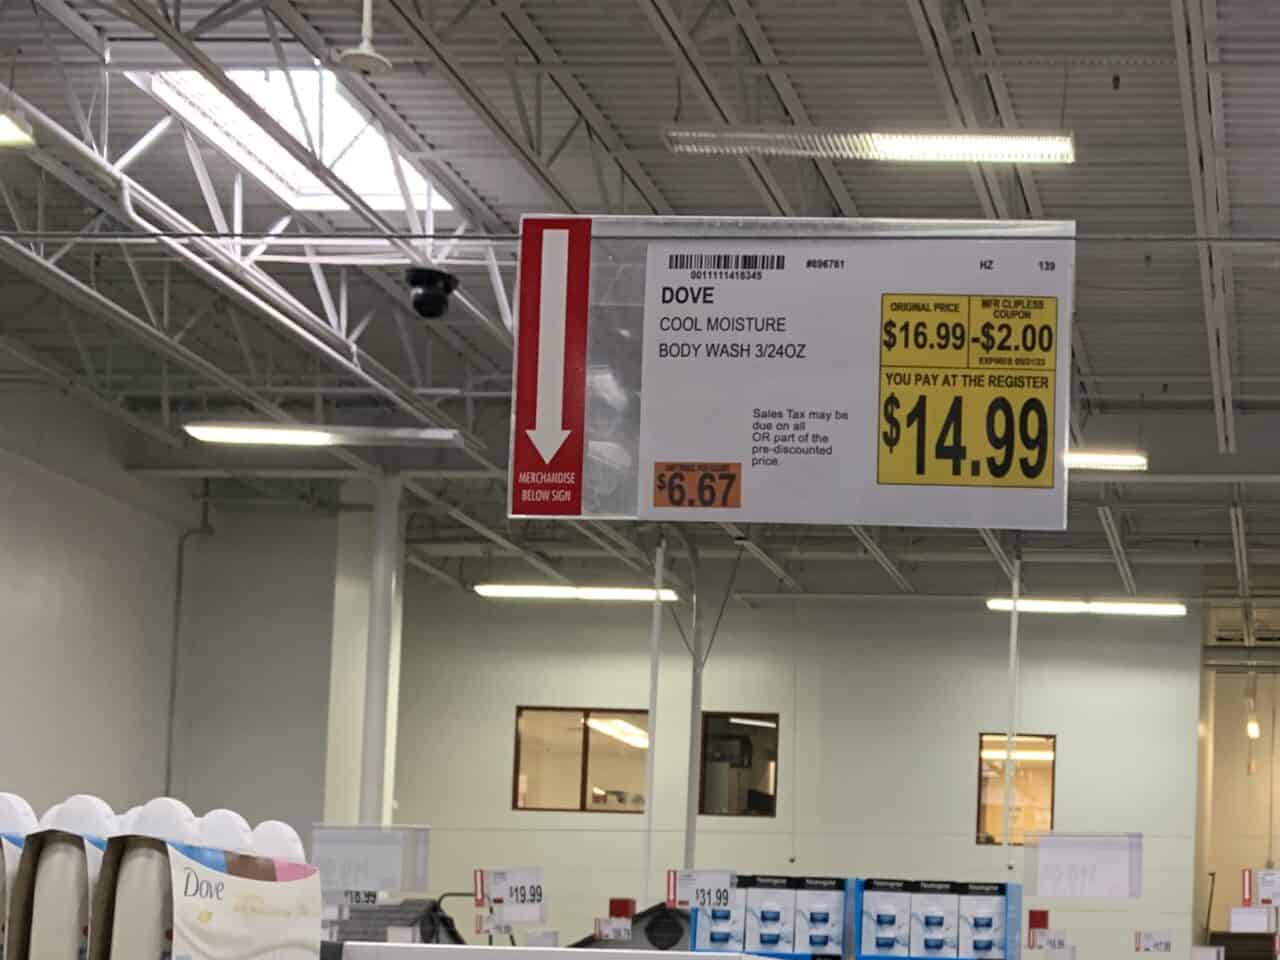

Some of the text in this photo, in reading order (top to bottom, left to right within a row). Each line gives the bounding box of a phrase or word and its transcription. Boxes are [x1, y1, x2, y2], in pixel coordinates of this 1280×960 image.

[661, 286, 714, 304] DOVE
[890, 303, 960, 312] ORIGINAL PRICE
[993, 310, 1031, 319] COUPON
[659, 317, 786, 332] COOL MOISTURE
[883, 320, 965, 350] $16.99
[971, 322, 1053, 353] -$2.00
[658, 344, 806, 358] BODY WASH 3/24OZ
[886, 373, 1049, 389] YOU PAY AT THE REGISTER
[752, 408, 848, 421] Sales Tax may be
[752, 421, 805, 431] due on all
[752, 432, 829, 445] OR part of the
[883, 394, 1048, 479] $14.99
[752, 445, 832, 457] pre-discounted
[519, 472, 576, 484] MERCHANDISE
[521, 490, 571, 502] BELOW SIGN
[657, 472, 736, 508] $6.67
[183, 867, 225, 900] Dove
[509, 885, 543, 903] $19.99
[696, 888, 729, 907] $31.99
